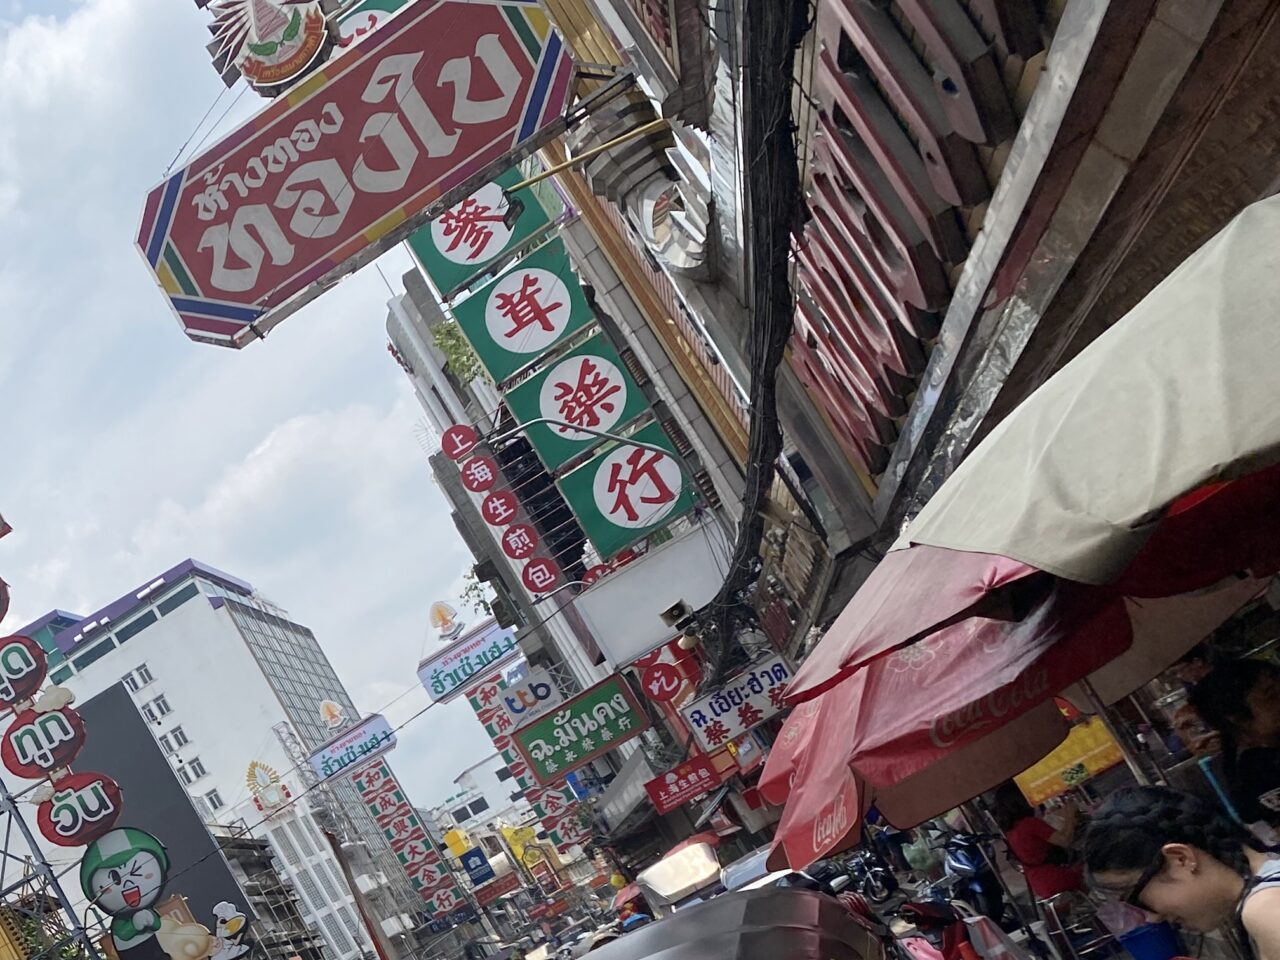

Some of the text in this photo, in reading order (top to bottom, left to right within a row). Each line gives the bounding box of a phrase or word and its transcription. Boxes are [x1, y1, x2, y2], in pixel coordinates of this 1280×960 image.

[191, 102, 344, 221] ห้างทอง
[450, 427, 554, 586] 上海生煎包
[504, 677, 551, 715] ttb
[11, 711, 74, 767] ทุก
[51, 781, 115, 835] วัน
